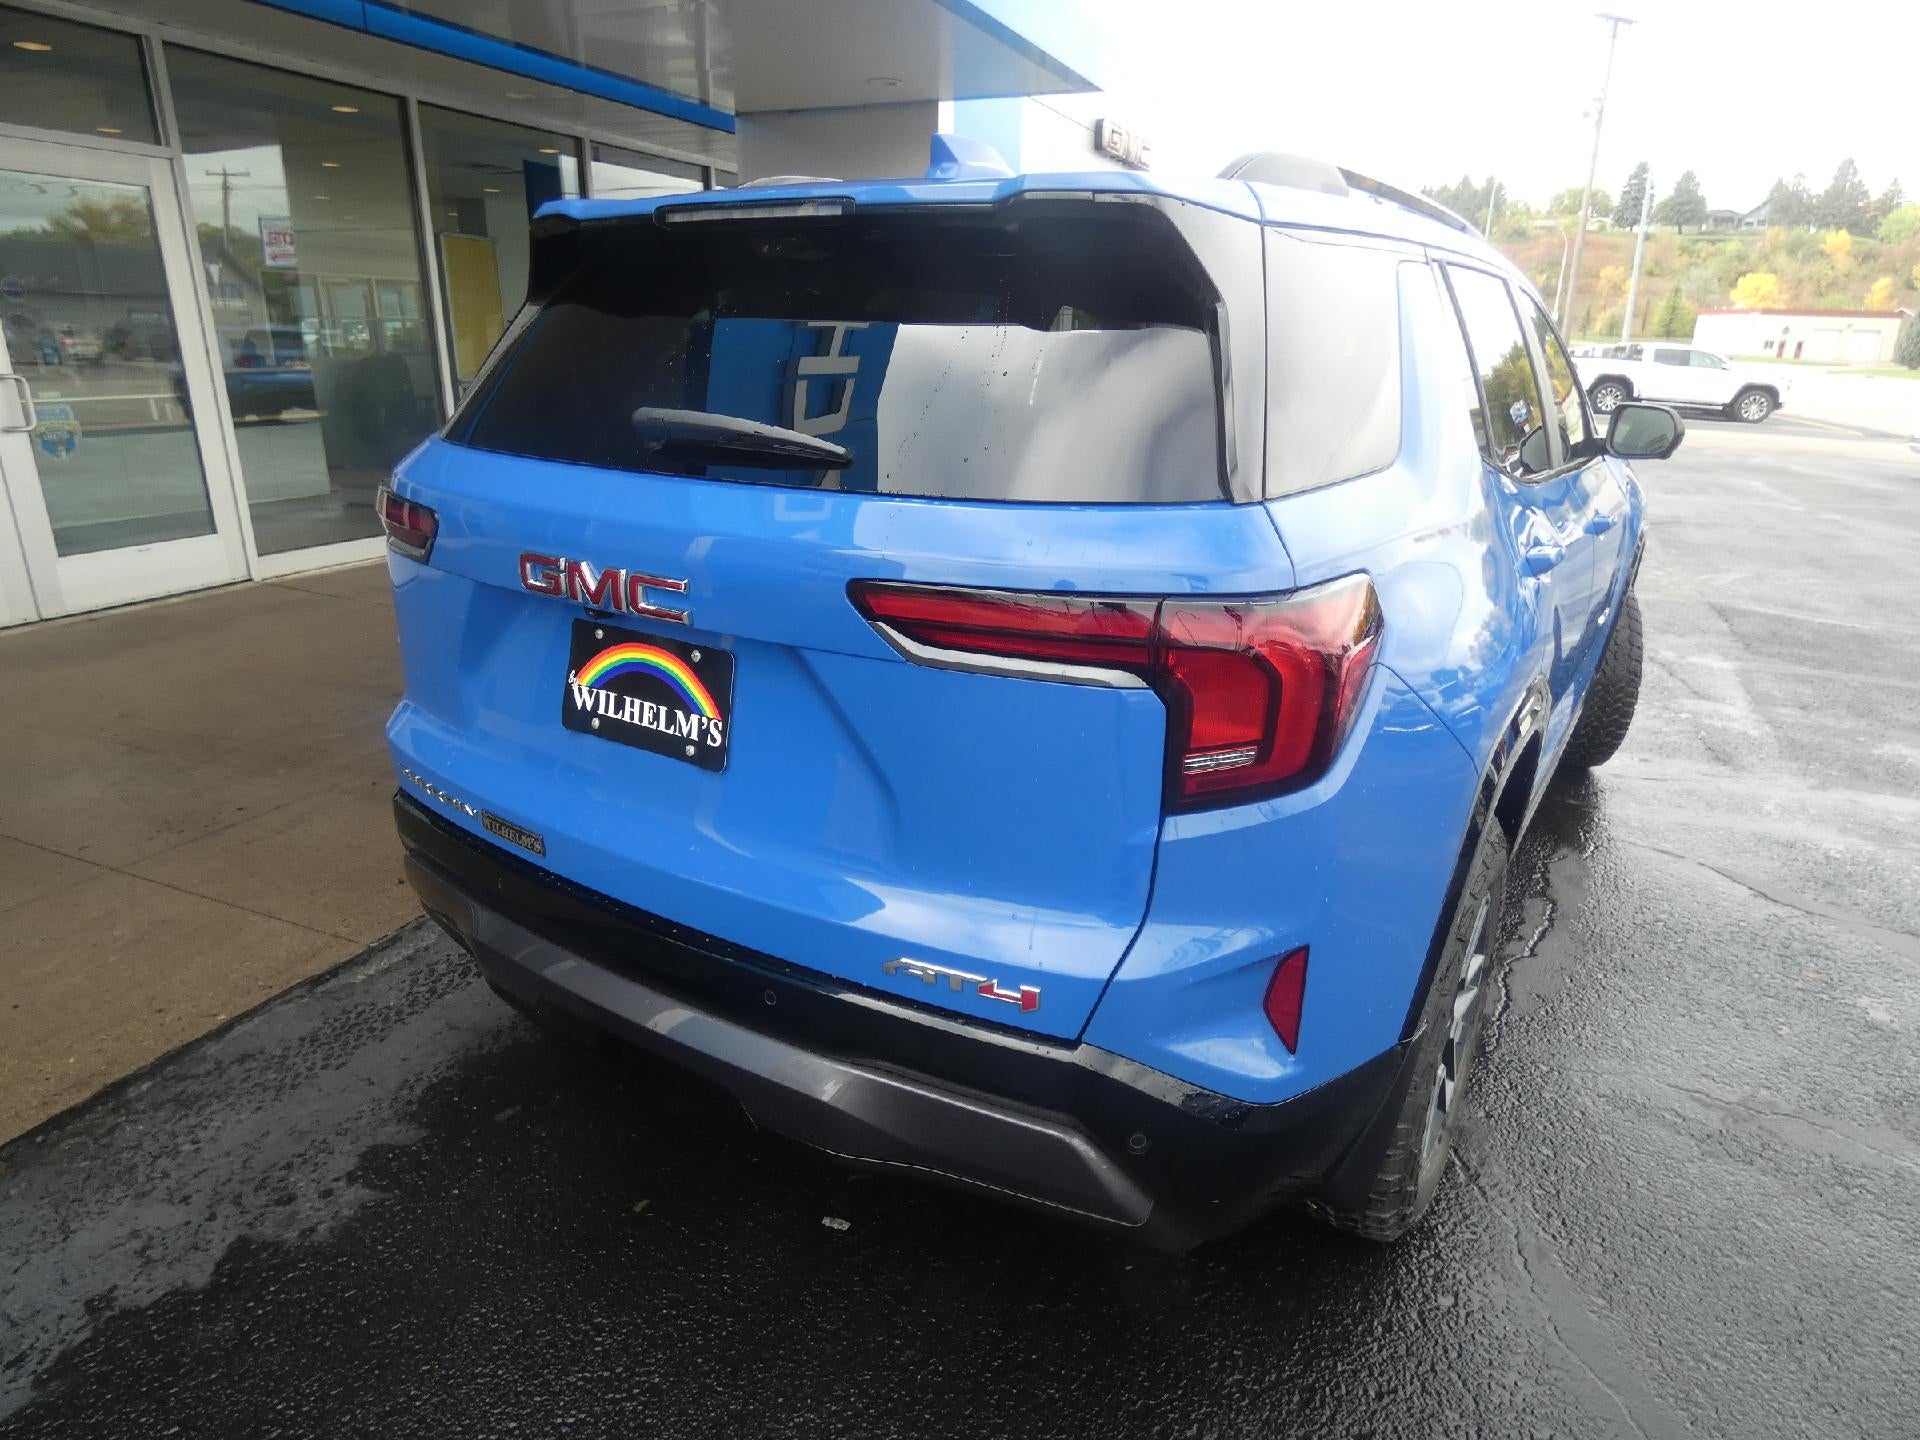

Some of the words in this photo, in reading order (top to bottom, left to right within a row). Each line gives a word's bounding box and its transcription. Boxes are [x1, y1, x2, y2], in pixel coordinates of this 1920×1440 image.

[1095, 118, 1151, 172] GMC
[518, 551, 693, 625] GMC
[571, 685, 723, 747] WILHELM'S
[882, 957, 1041, 1012] AT4
